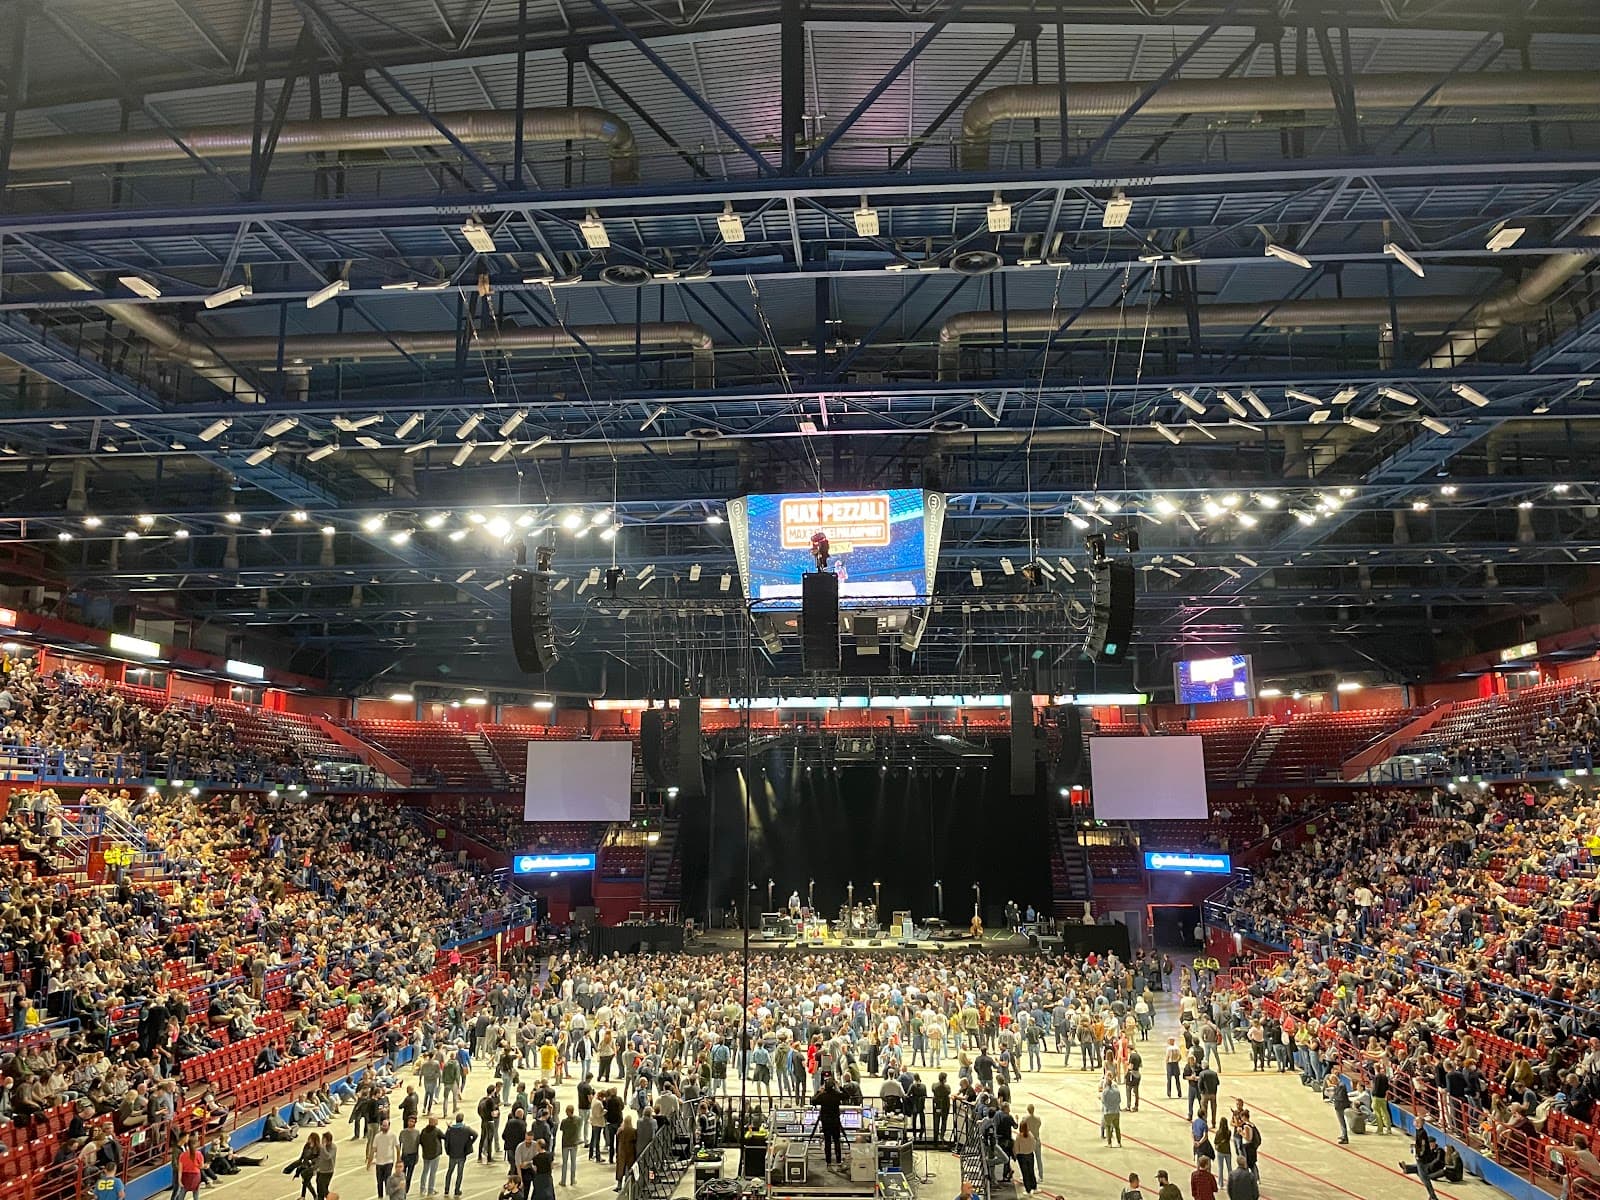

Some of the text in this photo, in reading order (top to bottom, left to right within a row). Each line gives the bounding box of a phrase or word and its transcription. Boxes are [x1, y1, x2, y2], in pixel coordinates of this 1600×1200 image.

[785, 501, 885, 523] MAX PEZZALI
[98, 1180, 115, 1190] 62
